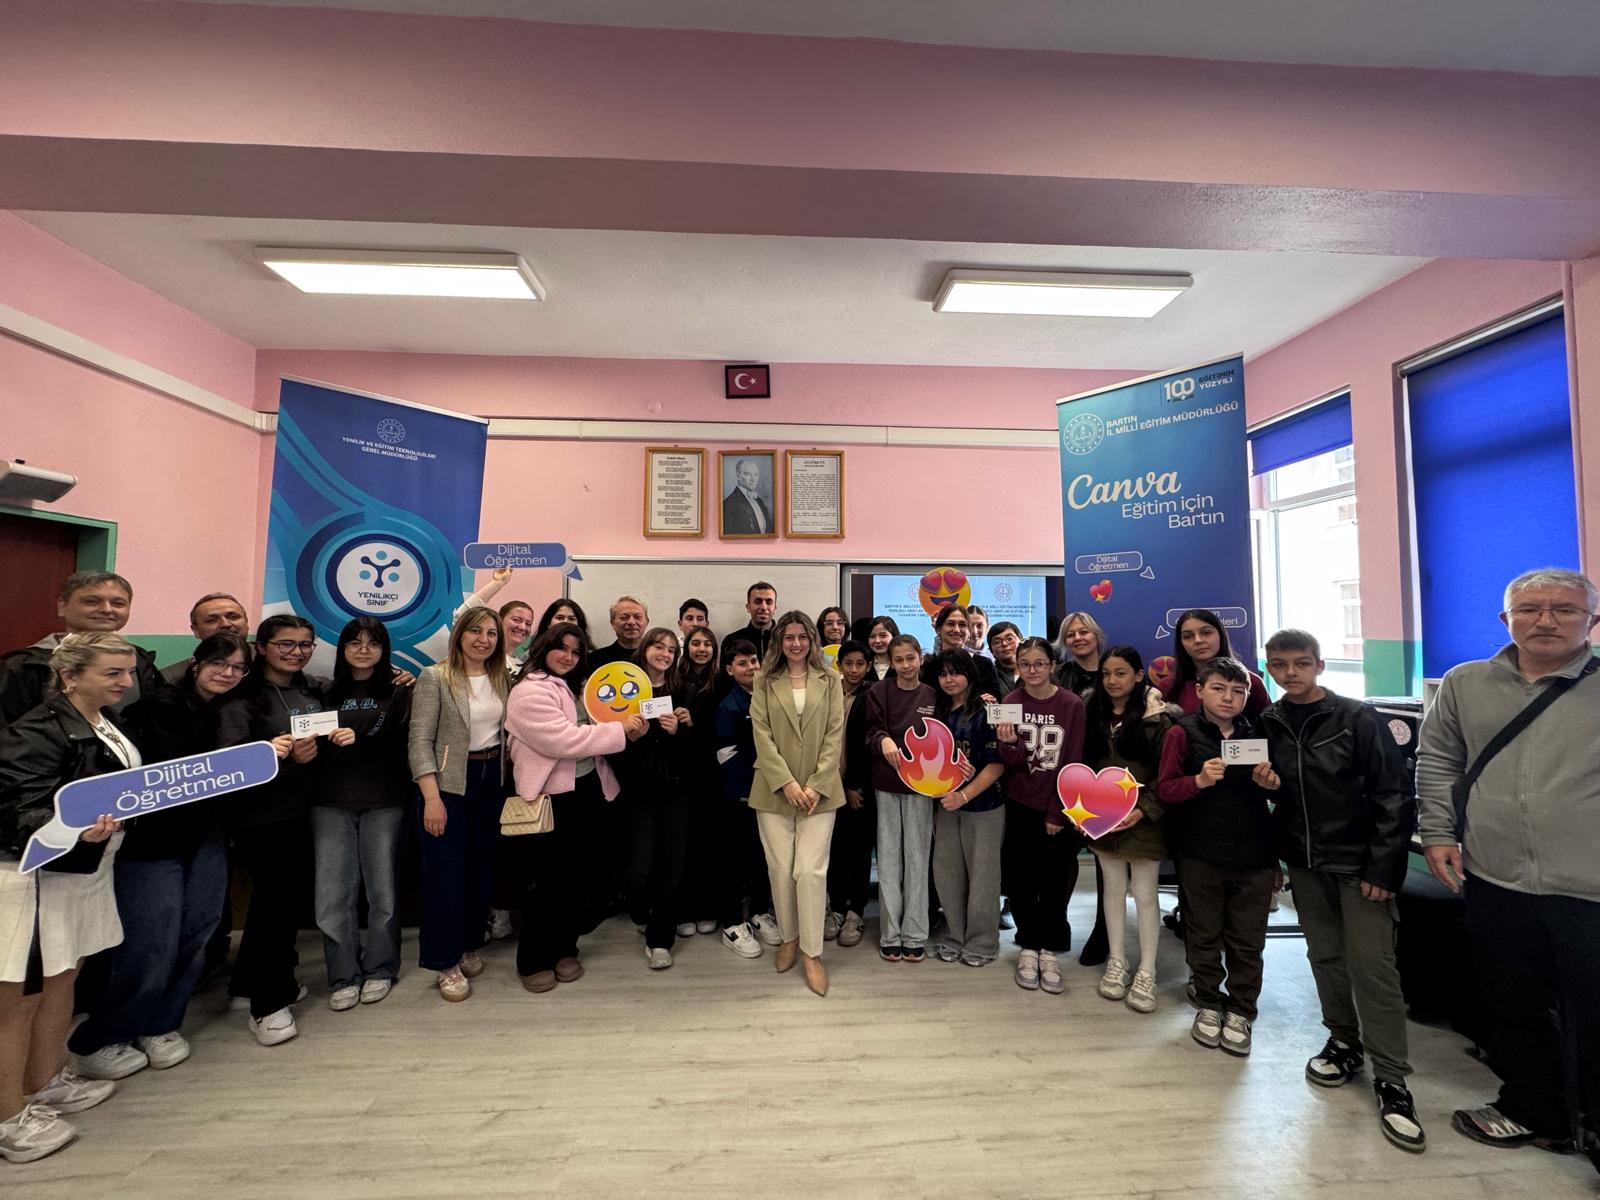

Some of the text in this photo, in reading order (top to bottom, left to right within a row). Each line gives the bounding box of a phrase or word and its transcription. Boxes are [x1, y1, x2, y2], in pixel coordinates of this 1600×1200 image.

[1163, 377, 1195, 400] 100
[1106, 400, 1239, 436] İL MİLLİ EĞİTİM MÜDÜRLÜĞÜ
[1106, 415, 1138, 428] BARTIN
[361, 446, 380, 454] GENEL
[374, 442, 395, 451] EĞİTİM
[395, 446, 436, 459] TEKNOLOJİLERİ
[1067, 471, 1181, 510] Canva
[1121, 493, 1214, 519] Eğitim için
[1168, 510, 1225, 529] Bartın
[497, 544, 531, 556] Dijital
[484, 554, 547, 567] Öğretmen
[1088, 562, 1129, 572] Öğretmen
[1096, 555, 1118, 563] Dijital
[1024, 713, 1055, 725] PARIS
[143, 757, 214, 787] Dijital
[116, 770, 245, 812] Öğretmen
